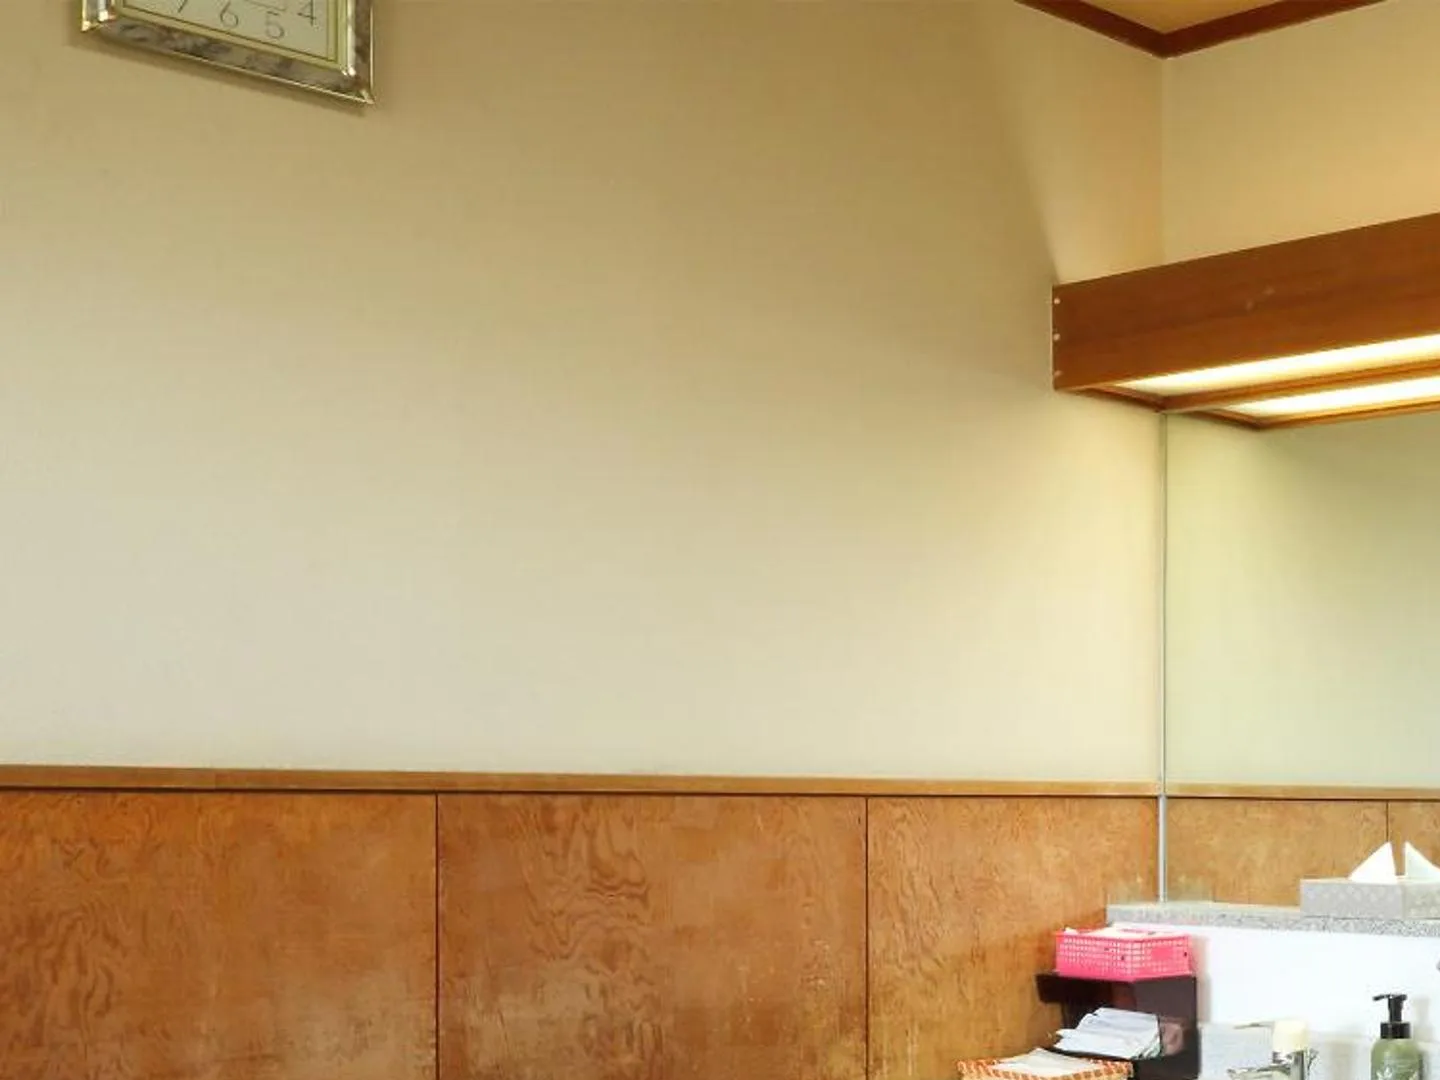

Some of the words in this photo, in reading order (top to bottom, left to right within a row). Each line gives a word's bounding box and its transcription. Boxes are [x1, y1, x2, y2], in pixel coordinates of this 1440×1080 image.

[219, 0, 240, 28] 6
[265, 10, 285, 39] 5
[297, 0, 317, 27] 4
